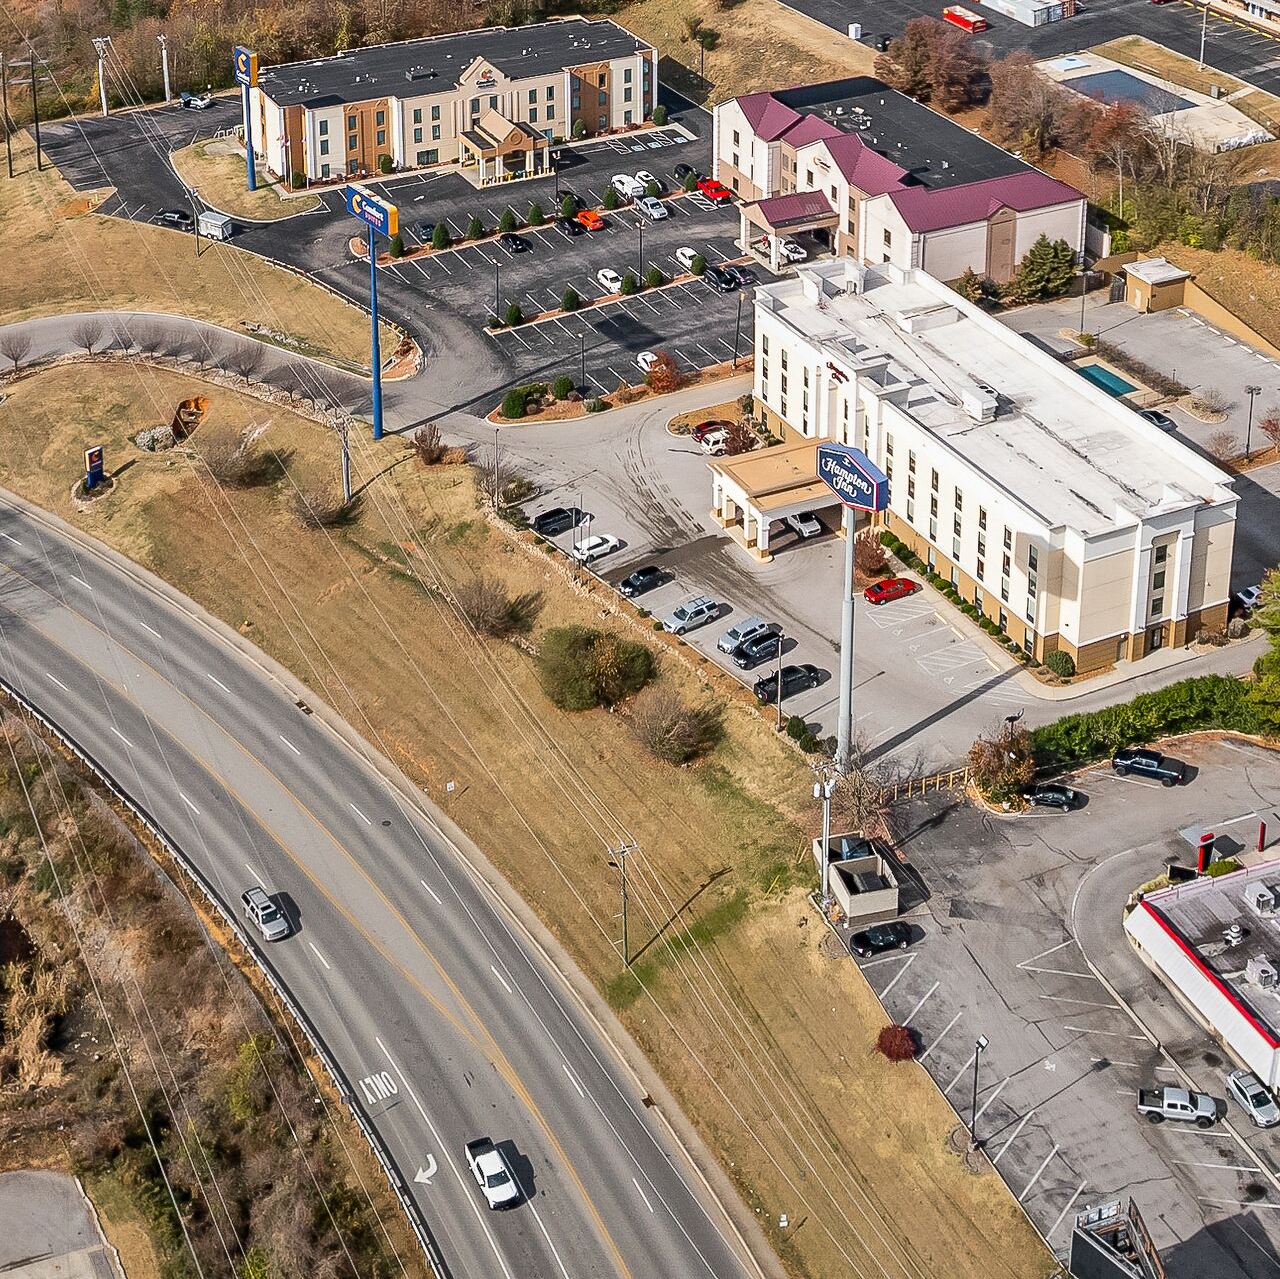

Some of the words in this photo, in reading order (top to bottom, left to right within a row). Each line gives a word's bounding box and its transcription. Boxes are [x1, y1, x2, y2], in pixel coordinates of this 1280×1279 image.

[821, 457, 872, 495] Hampton
[832, 476, 857, 498] Inn
[358, 1071, 398, 1105] ONLY
